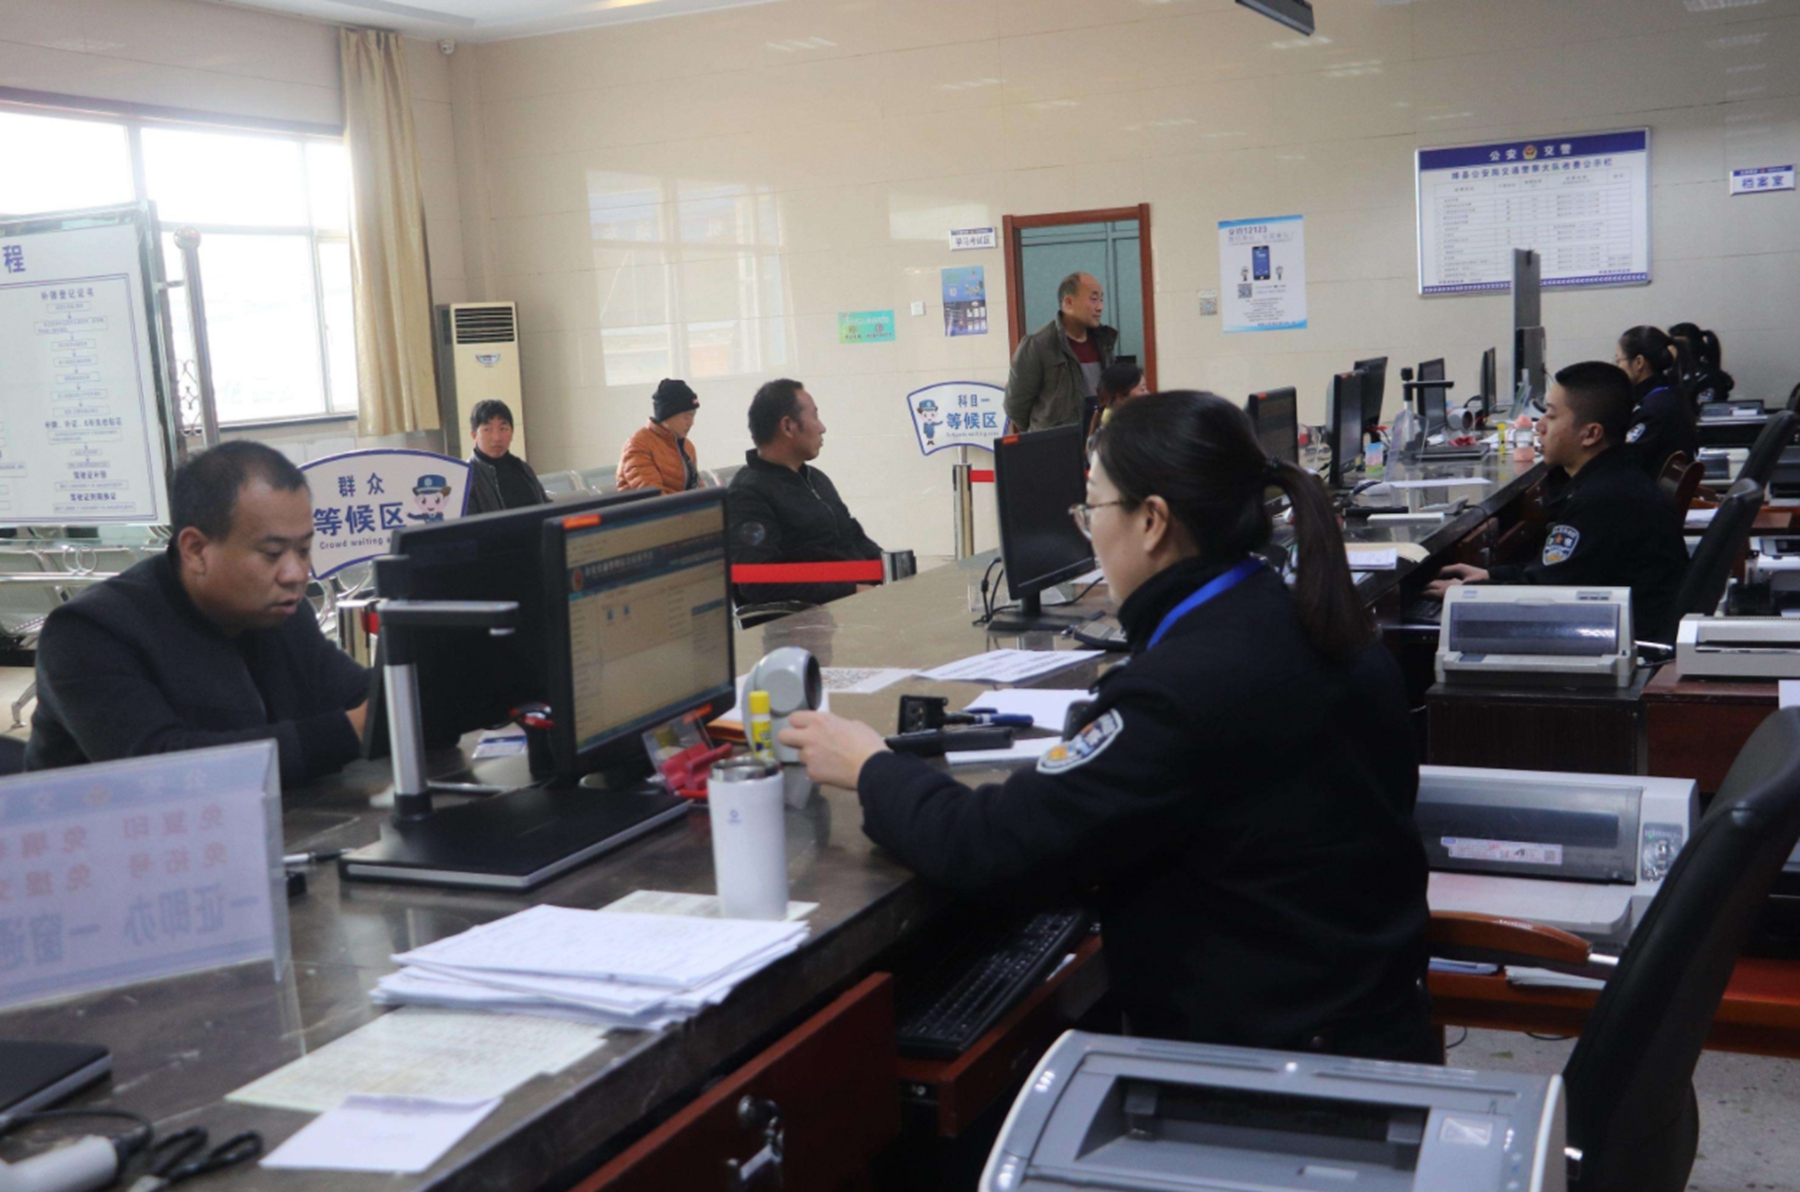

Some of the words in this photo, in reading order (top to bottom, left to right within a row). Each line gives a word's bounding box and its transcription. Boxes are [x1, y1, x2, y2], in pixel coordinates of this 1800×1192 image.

[1489, 148, 1517, 161] 公安
[1543, 143, 1572, 156] 交警
[1742, 174, 1784, 189] 档案室
[2, 244, 26, 274] 程
[957, 393, 991, 408] 科目一
[946, 411, 998, 430] 等候区
[338, 472, 385, 497] 群众
[313, 501, 407, 537] 等候区
[319, 539, 348, 550] Crowd
[351, 536, 384, 547] waiting
